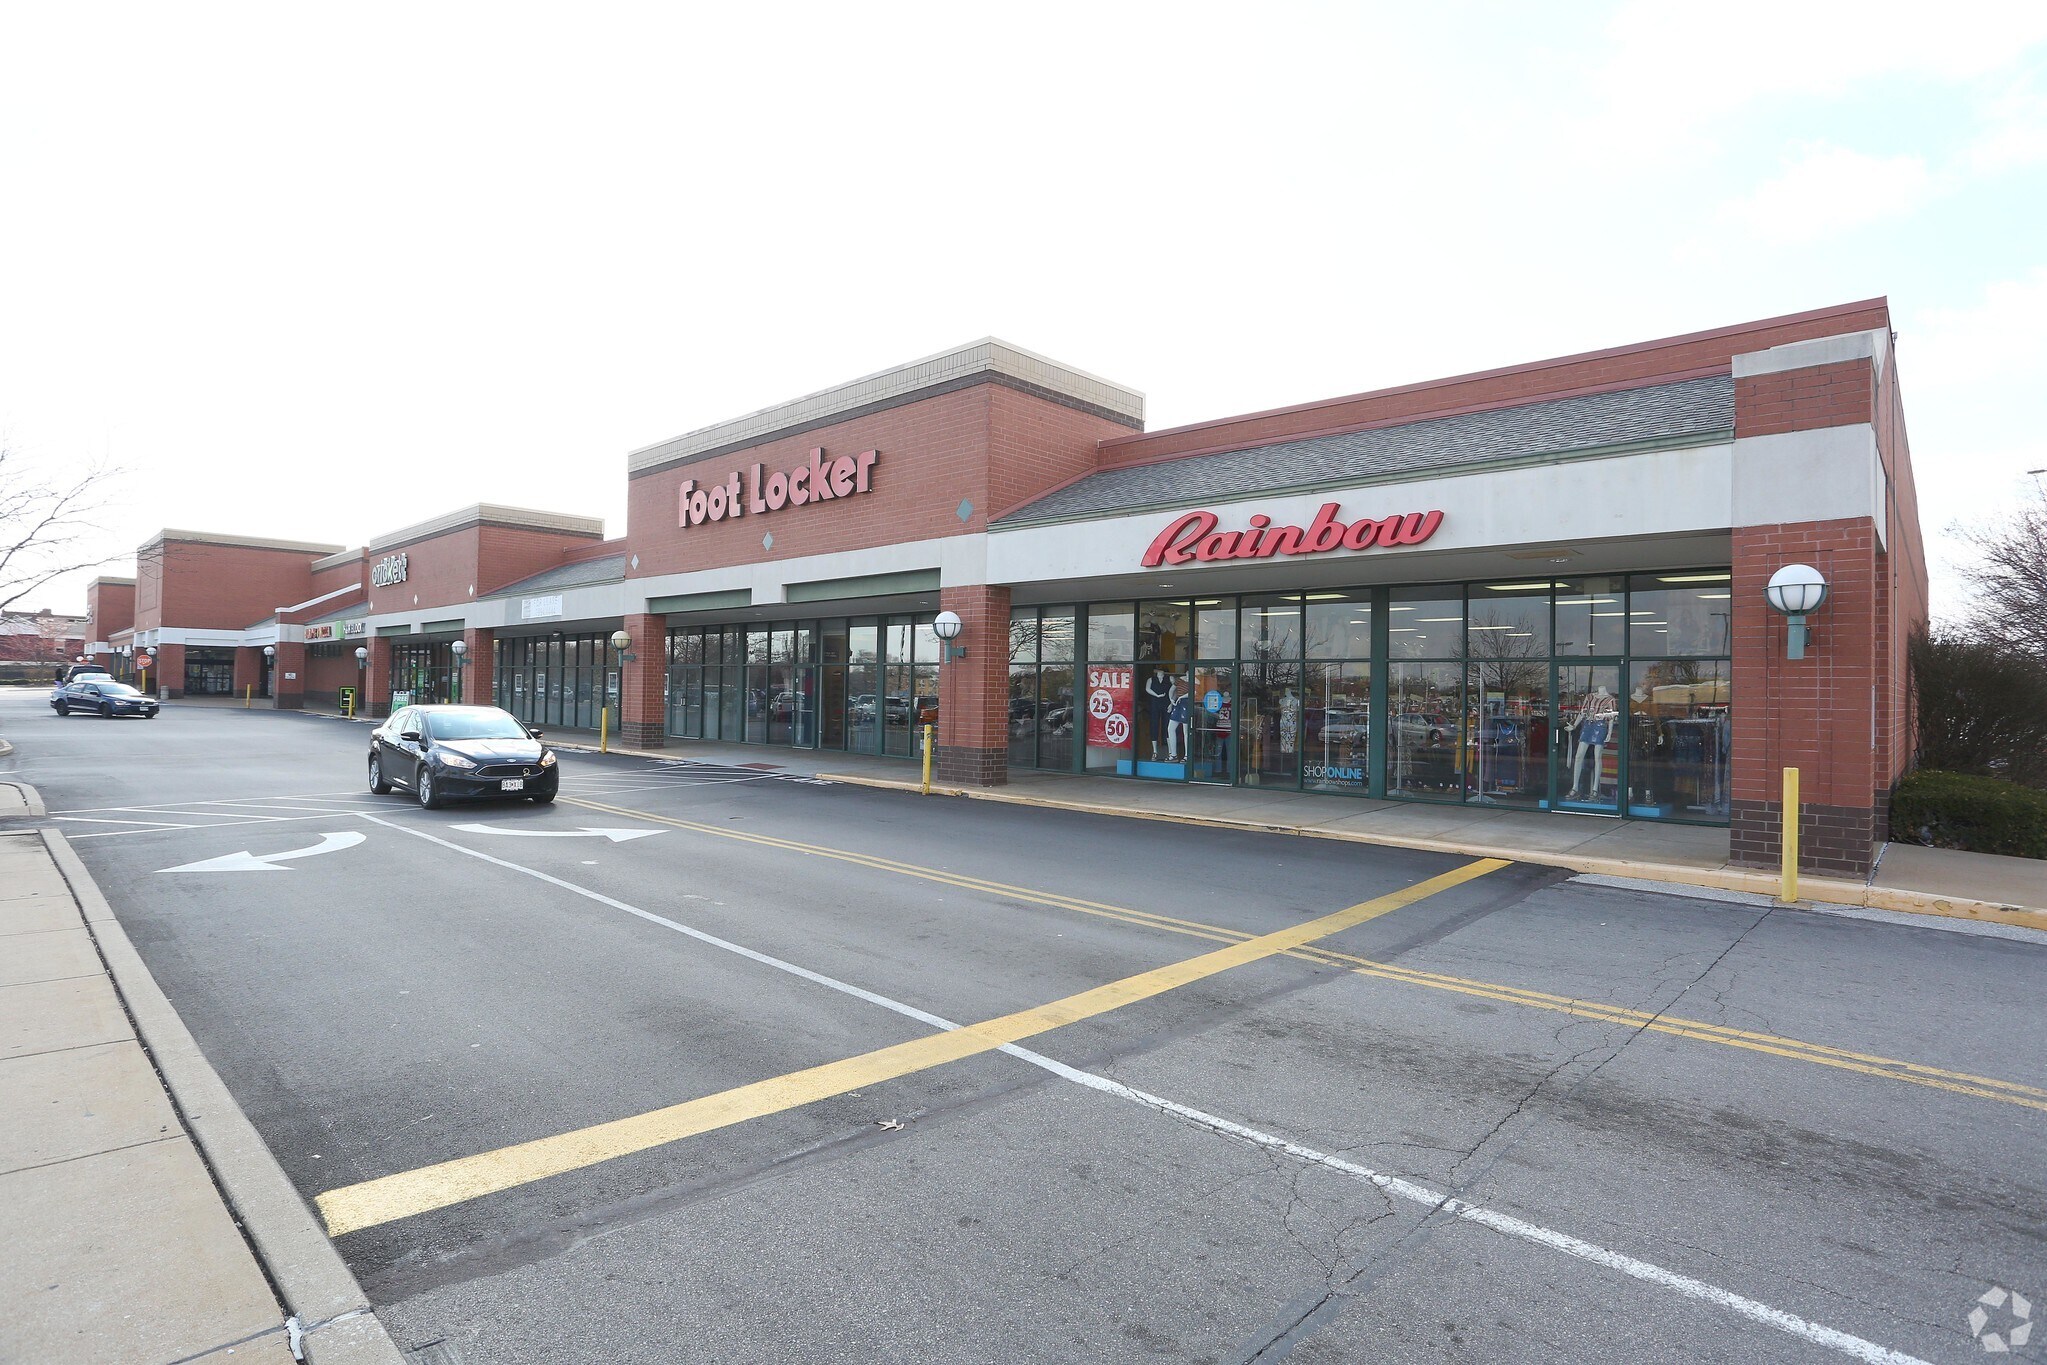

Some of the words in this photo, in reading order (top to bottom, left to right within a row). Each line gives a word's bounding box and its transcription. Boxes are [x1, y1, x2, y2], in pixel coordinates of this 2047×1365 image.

[679, 479, 742, 528] Foot
[751, 446, 880, 514] Locker
[1140, 502, 1445, 568] Rainbow
[372, 553, 408, 587] cricket
[1089, 671, 1130, 689] SALE
[394, 694, 408, 702] FREE
